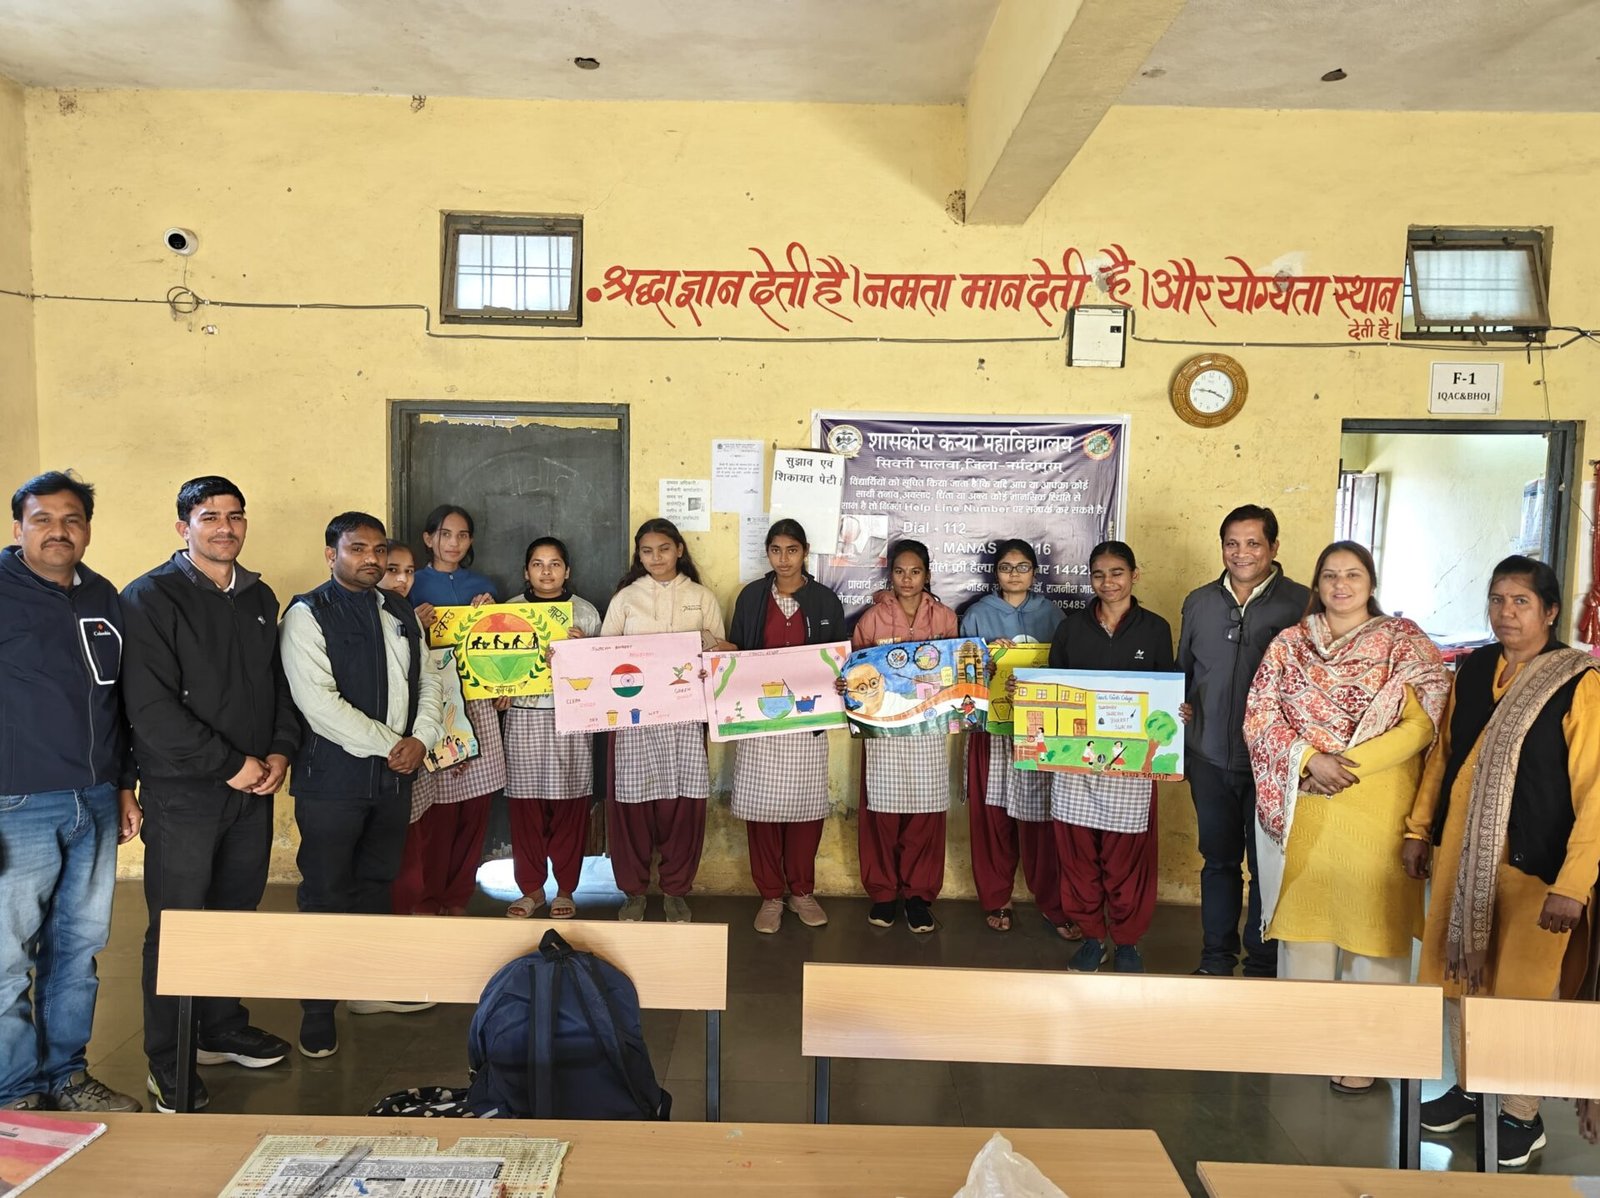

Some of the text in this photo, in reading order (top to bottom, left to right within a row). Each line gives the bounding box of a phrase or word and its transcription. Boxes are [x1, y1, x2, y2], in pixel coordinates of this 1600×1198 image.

[602, 265, 680, 328] श्रद्धा
[676, 270, 753, 327] ज्ञान
[748, 241, 814, 332] देती
[960, 273, 1028, 312] मान
[1026, 247, 1092, 327] देती
[1149, 257, 1217, 327] और
[1332, 274, 1402, 320] स्थान
[1348, 318, 1375, 341] देती
[1453, 371, 1476, 385] F-1
[867, 426, 934, 452] शासकीय
[937, 432, 978, 452] कन्या
[982, 428, 1074, 455] महाविद्यालय
[785, 456, 834, 469] सुझाव एवं
[876, 456, 915, 469] सिवनी
[774, 471, 813, 484] शिकायत
[849, 475, 886, 487] विद्यार्थियों
[888, 477, 900, 486] को
[902, 477, 924, 489] सूचित
[926, 477, 947, 487] किया
[904, 503, 931, 513] Help
[934, 503, 960, 512] Line
[963, 503, 1010, 513] Number
[903, 521, 930, 534] Dial
[943, 522, 966, 534] 112
[943, 543, 997, 555] MANAS
[1054, 565, 1091, 576] 1442
